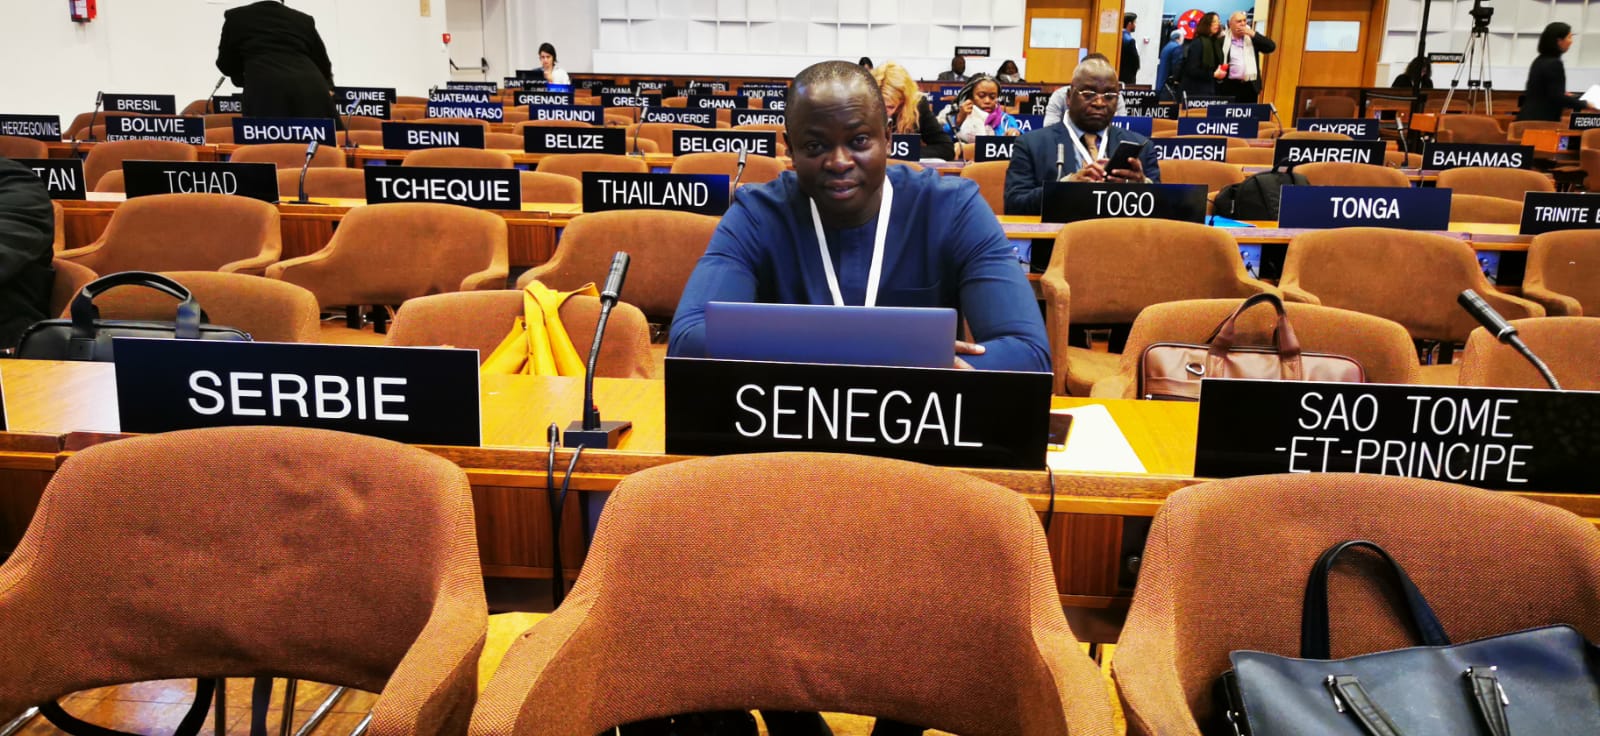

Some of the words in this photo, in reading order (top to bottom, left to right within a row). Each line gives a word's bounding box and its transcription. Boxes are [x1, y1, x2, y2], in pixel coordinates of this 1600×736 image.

[346, 90, 386, 101] GUINEE
[519, 95, 569, 105] GRENADE
[612, 96, 648, 107] GRECE
[117, 99, 161, 111] BRESIL
[699, 99, 736, 109] GHANA
[769, 101, 787, 110] GE
[429, 106, 474, 119] BURKINA
[475, 107, 502, 120] FASO
[538, 109, 595, 122] BURUNDI
[648, 111, 675, 123] CABO
[676, 113, 710, 124] VERDE
[737, 114, 785, 126] CAMERO
[1225, 107, 1252, 118] FIDJI
[1, 121, 61, 136] HERZEGOVINE
[121, 118, 185, 133] BOLIVIE
[243, 125, 326, 141] BHOUTAN
[1196, 122, 1239, 135] CHINE
[1309, 124, 1367, 136] CHYPRE
[408, 130, 460, 146] BENIN
[545, 133, 604, 150] BELIZE
[680, 137, 768, 153] BELGIQUE
[890, 142, 909, 156] US
[1154, 145, 1225, 161] GLADESH
[1288, 147, 1371, 163] BAHREIN
[1432, 150, 1522, 168] BAHAMAS
[32, 167, 76, 191] TAN
[163, 171, 237, 194] TCHAD
[376, 178, 510, 201] TCHEQUIE
[598, 180, 709, 206] THAILAND
[1092, 190, 1154, 216] TOGO
[1330, 197, 1400, 219] TONGA
[1534, 206, 1589, 223] TRINITE
[188, 371, 409, 421] SERBIE
[735, 384, 983, 447] SENEGAL
[1298, 392, 1379, 431] SAO
[1407, 397, 1518, 437] TOME
